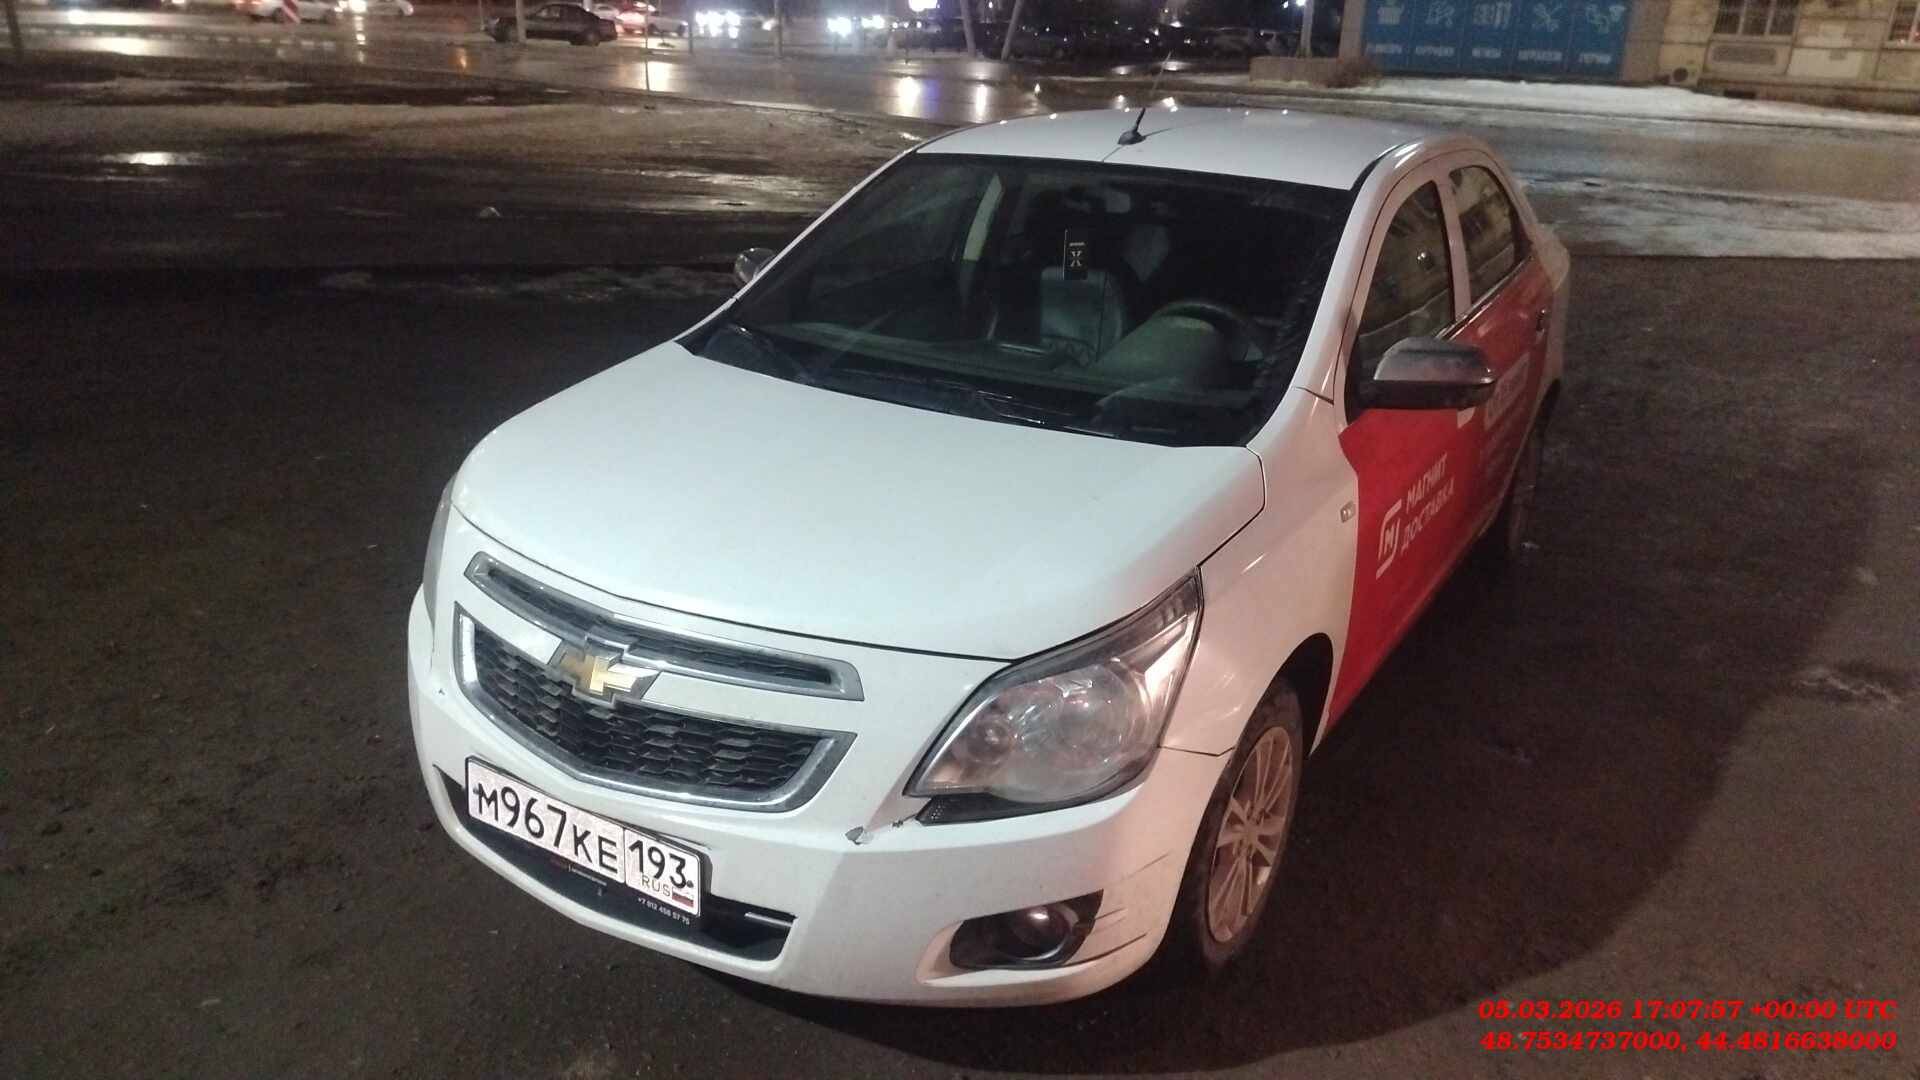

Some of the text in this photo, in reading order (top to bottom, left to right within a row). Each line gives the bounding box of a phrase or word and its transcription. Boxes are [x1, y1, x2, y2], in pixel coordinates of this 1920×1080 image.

[1400, 476, 1455, 557] ДОСТАВКА
[1406, 451, 1447, 514] МАГНИТ
[477, 783, 687, 889] М967КЕ 193
[641, 875, 671, 897] RUS
